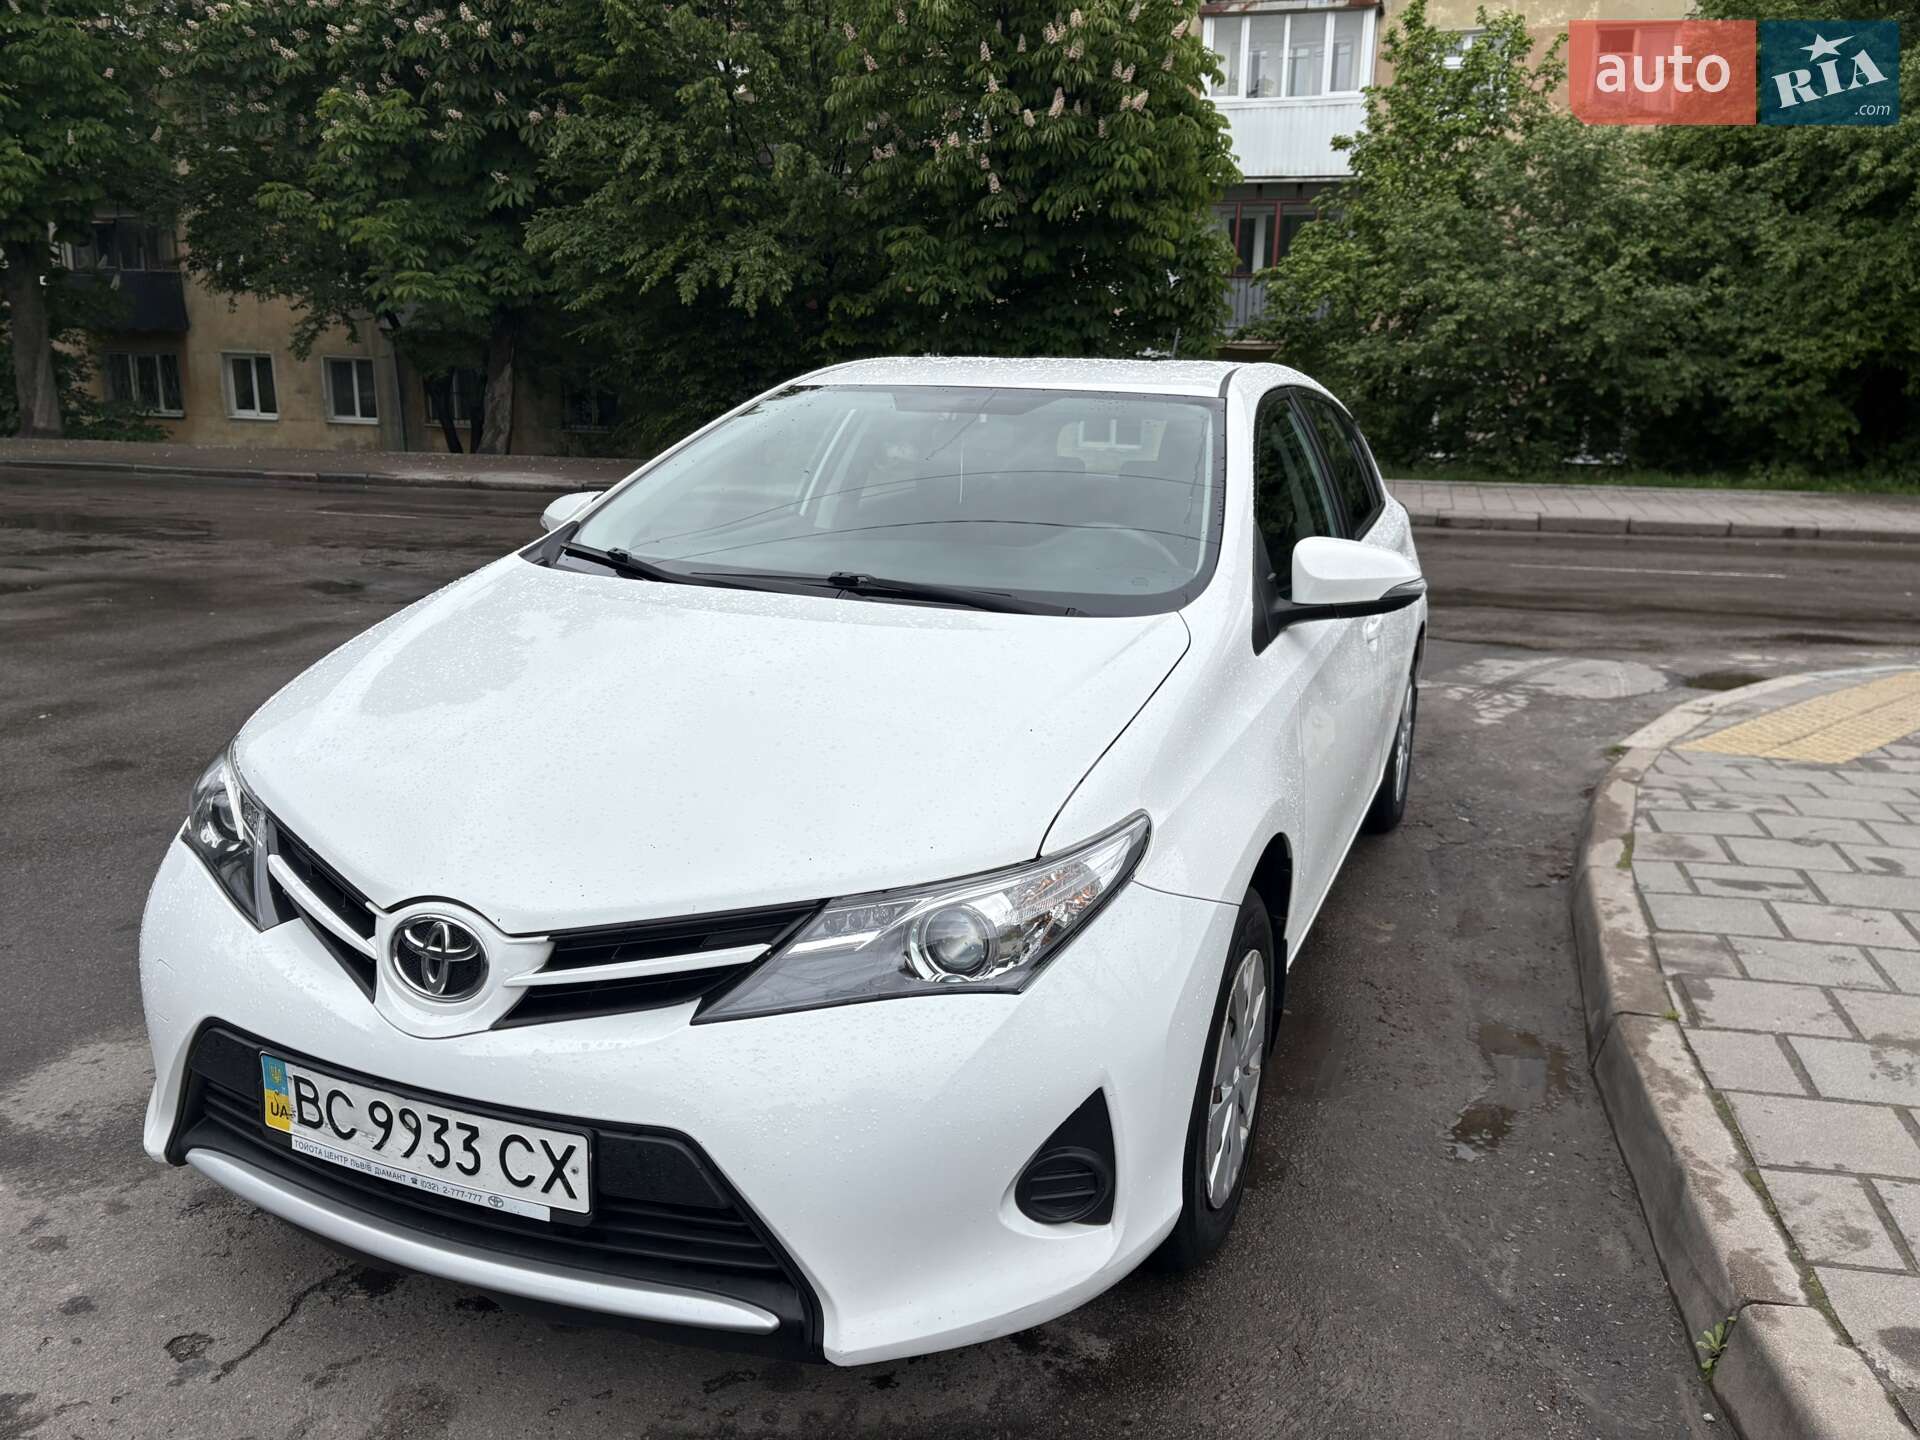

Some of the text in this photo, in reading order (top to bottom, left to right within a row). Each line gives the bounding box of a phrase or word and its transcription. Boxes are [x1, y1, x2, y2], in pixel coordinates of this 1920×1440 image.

[270, 1101, 289, 1120] UA
[293, 1075, 577, 1199] BC 9933 CX
[295, 1139, 323, 1157] ТОЙОТА
[324, 1151, 348, 1164] ЦЕНТР
[442, 1185, 482, 1201] 2-777-777
